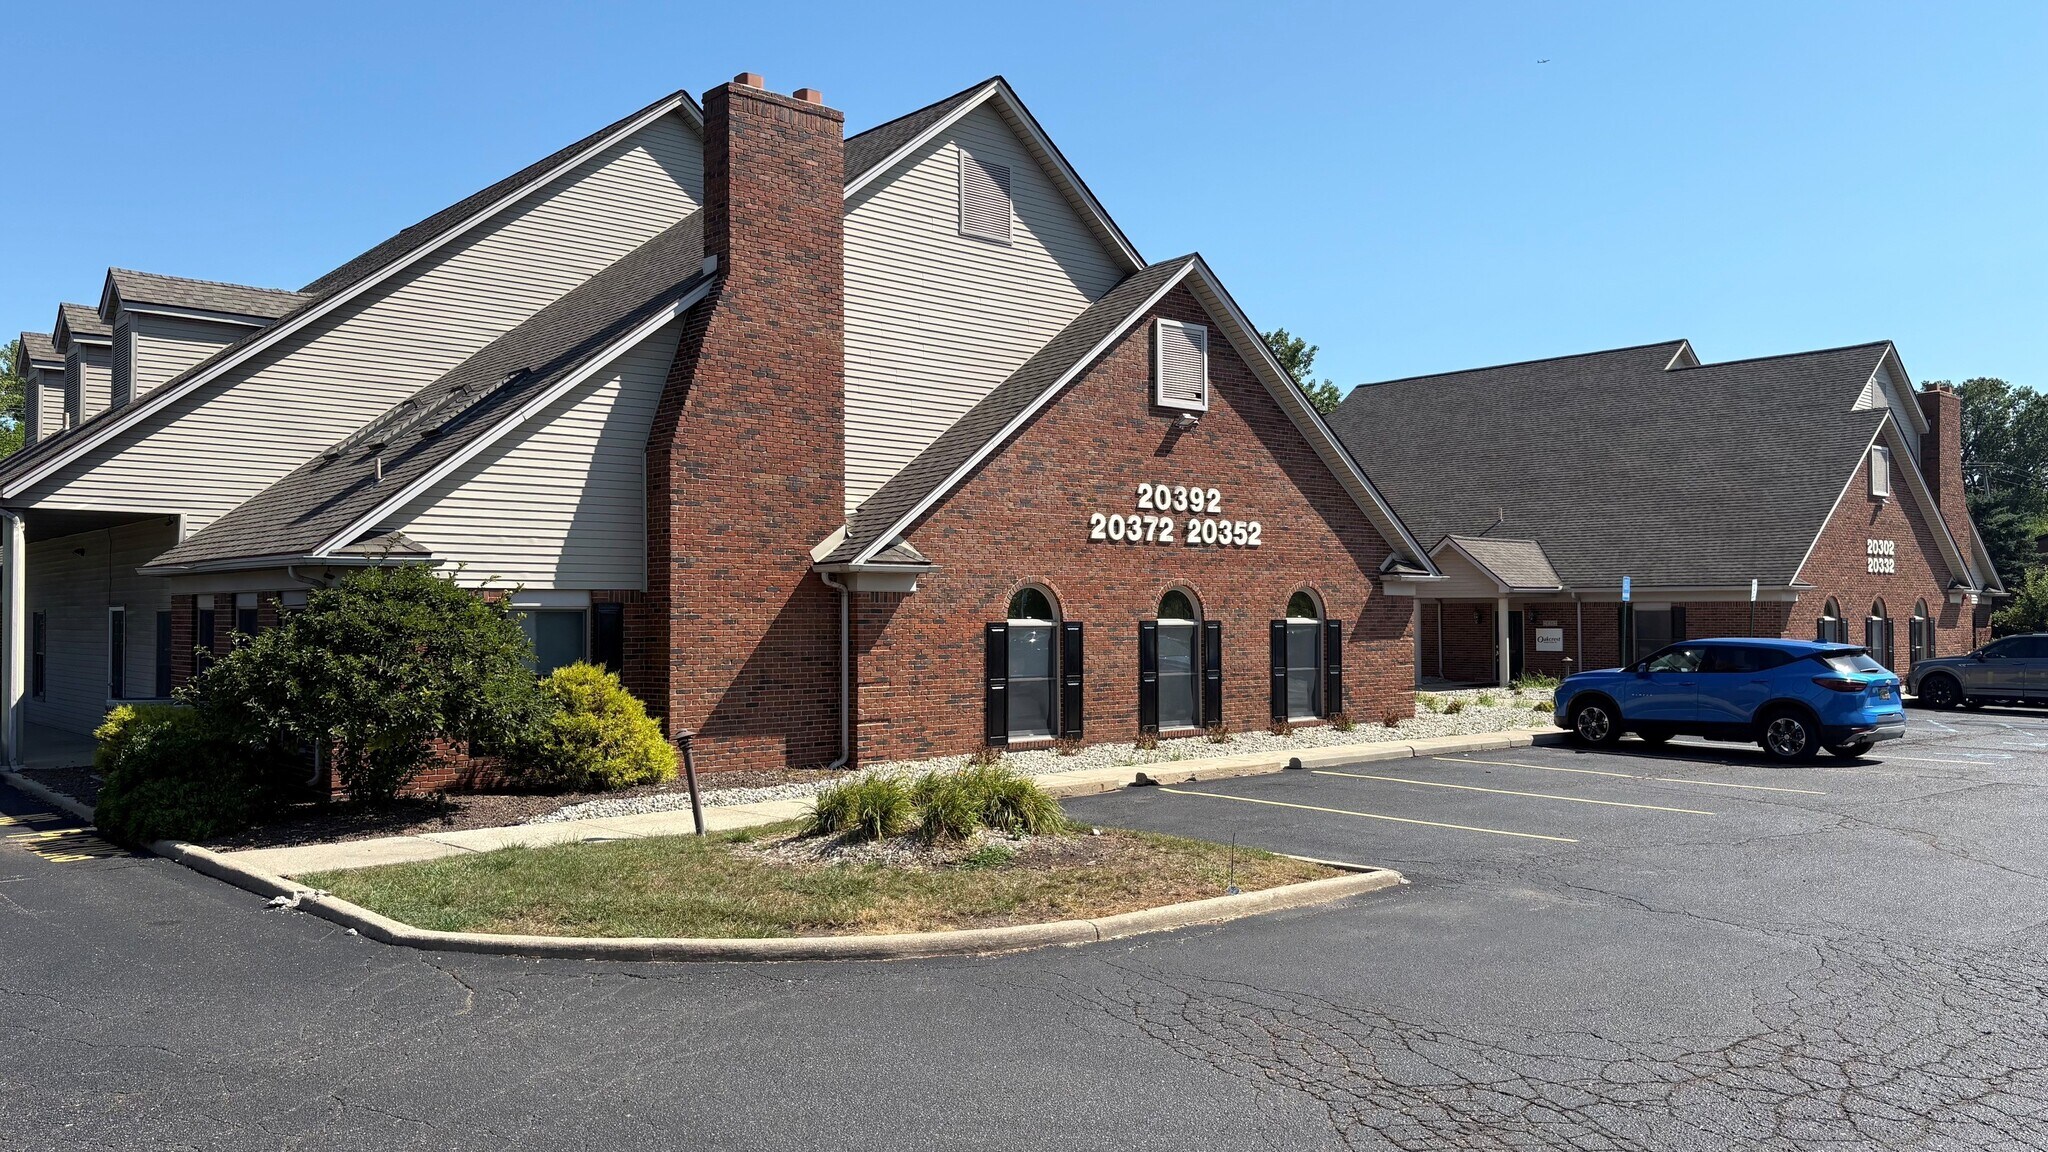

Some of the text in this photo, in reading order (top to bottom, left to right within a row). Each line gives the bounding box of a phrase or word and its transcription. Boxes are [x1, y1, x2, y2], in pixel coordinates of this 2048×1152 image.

[1137, 482, 1222, 513] 20392
[1089, 512, 1262, 546] 20372 20352
[1867, 538, 1895, 556] 20302
[1867, 557, 1895, 574] 20332
